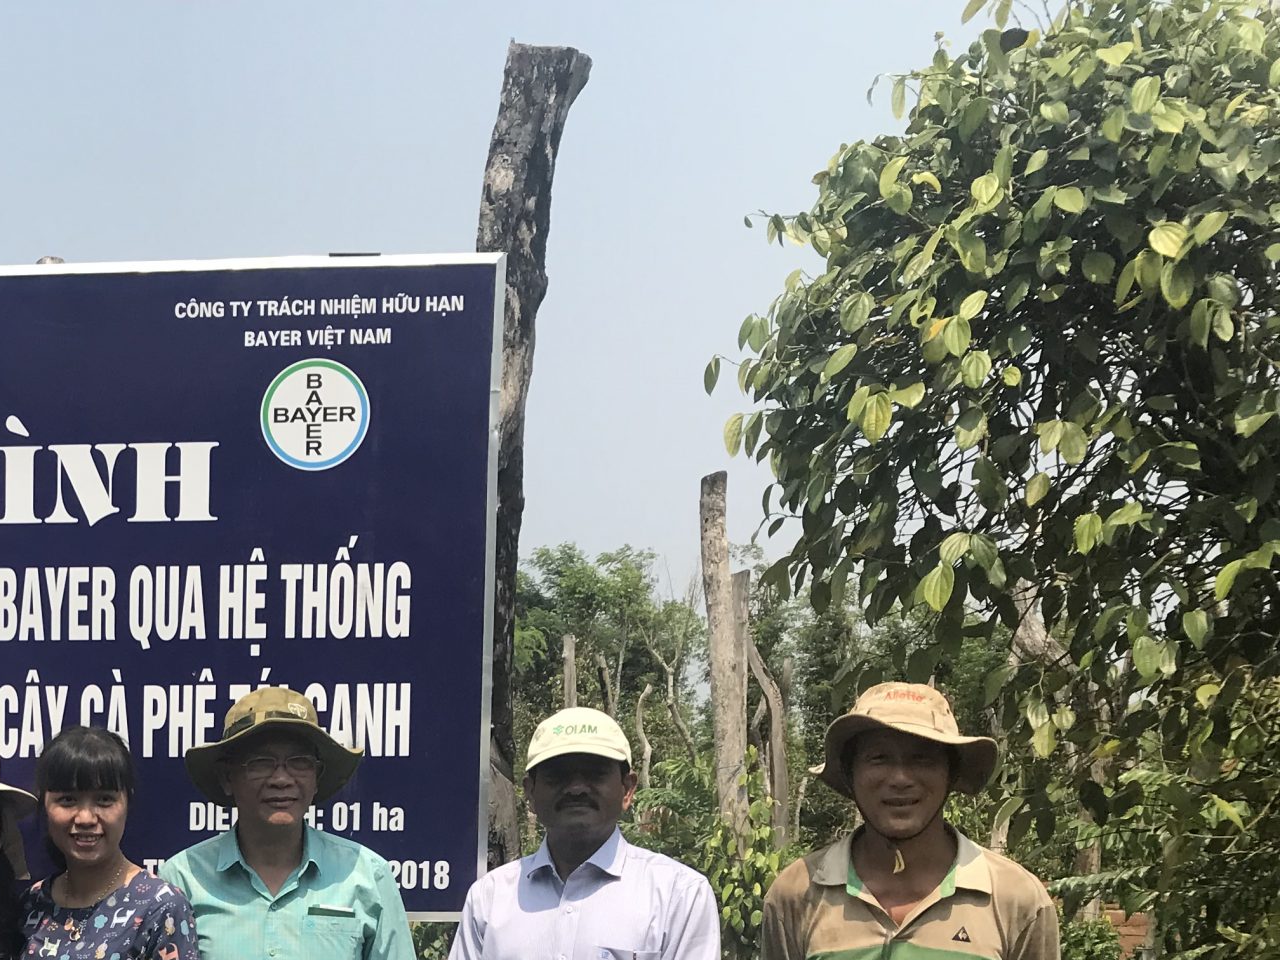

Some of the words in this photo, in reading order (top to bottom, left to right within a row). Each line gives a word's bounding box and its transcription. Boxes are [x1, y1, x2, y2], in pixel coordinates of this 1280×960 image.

[174, 297, 225, 319] CÔNG
[229, 300, 253, 317] TY
[256, 295, 316, 317] TRÁCH
[320, 294, 377, 319] NHIỆM
[382, 292, 421, 314] HỮU
[425, 295, 464, 317] HẠN
[244, 329, 302, 347] BAYER
[306, 324, 346, 350] VIỆT
[349, 327, 392, 345] NAM
[273, 406, 356, 423] BAYER
[305, 373, 323, 456] BAYER
[128, 564, 207, 650] QUA
[218, 547, 268, 657] HỆ
[280, 535, 412, 640] THỐNG
[80, 668, 130, 752] CÀ
[142, 667, 217, 758] PHÊ
[332, 801, 361, 832] 01
[372, 801, 405, 832] ha
